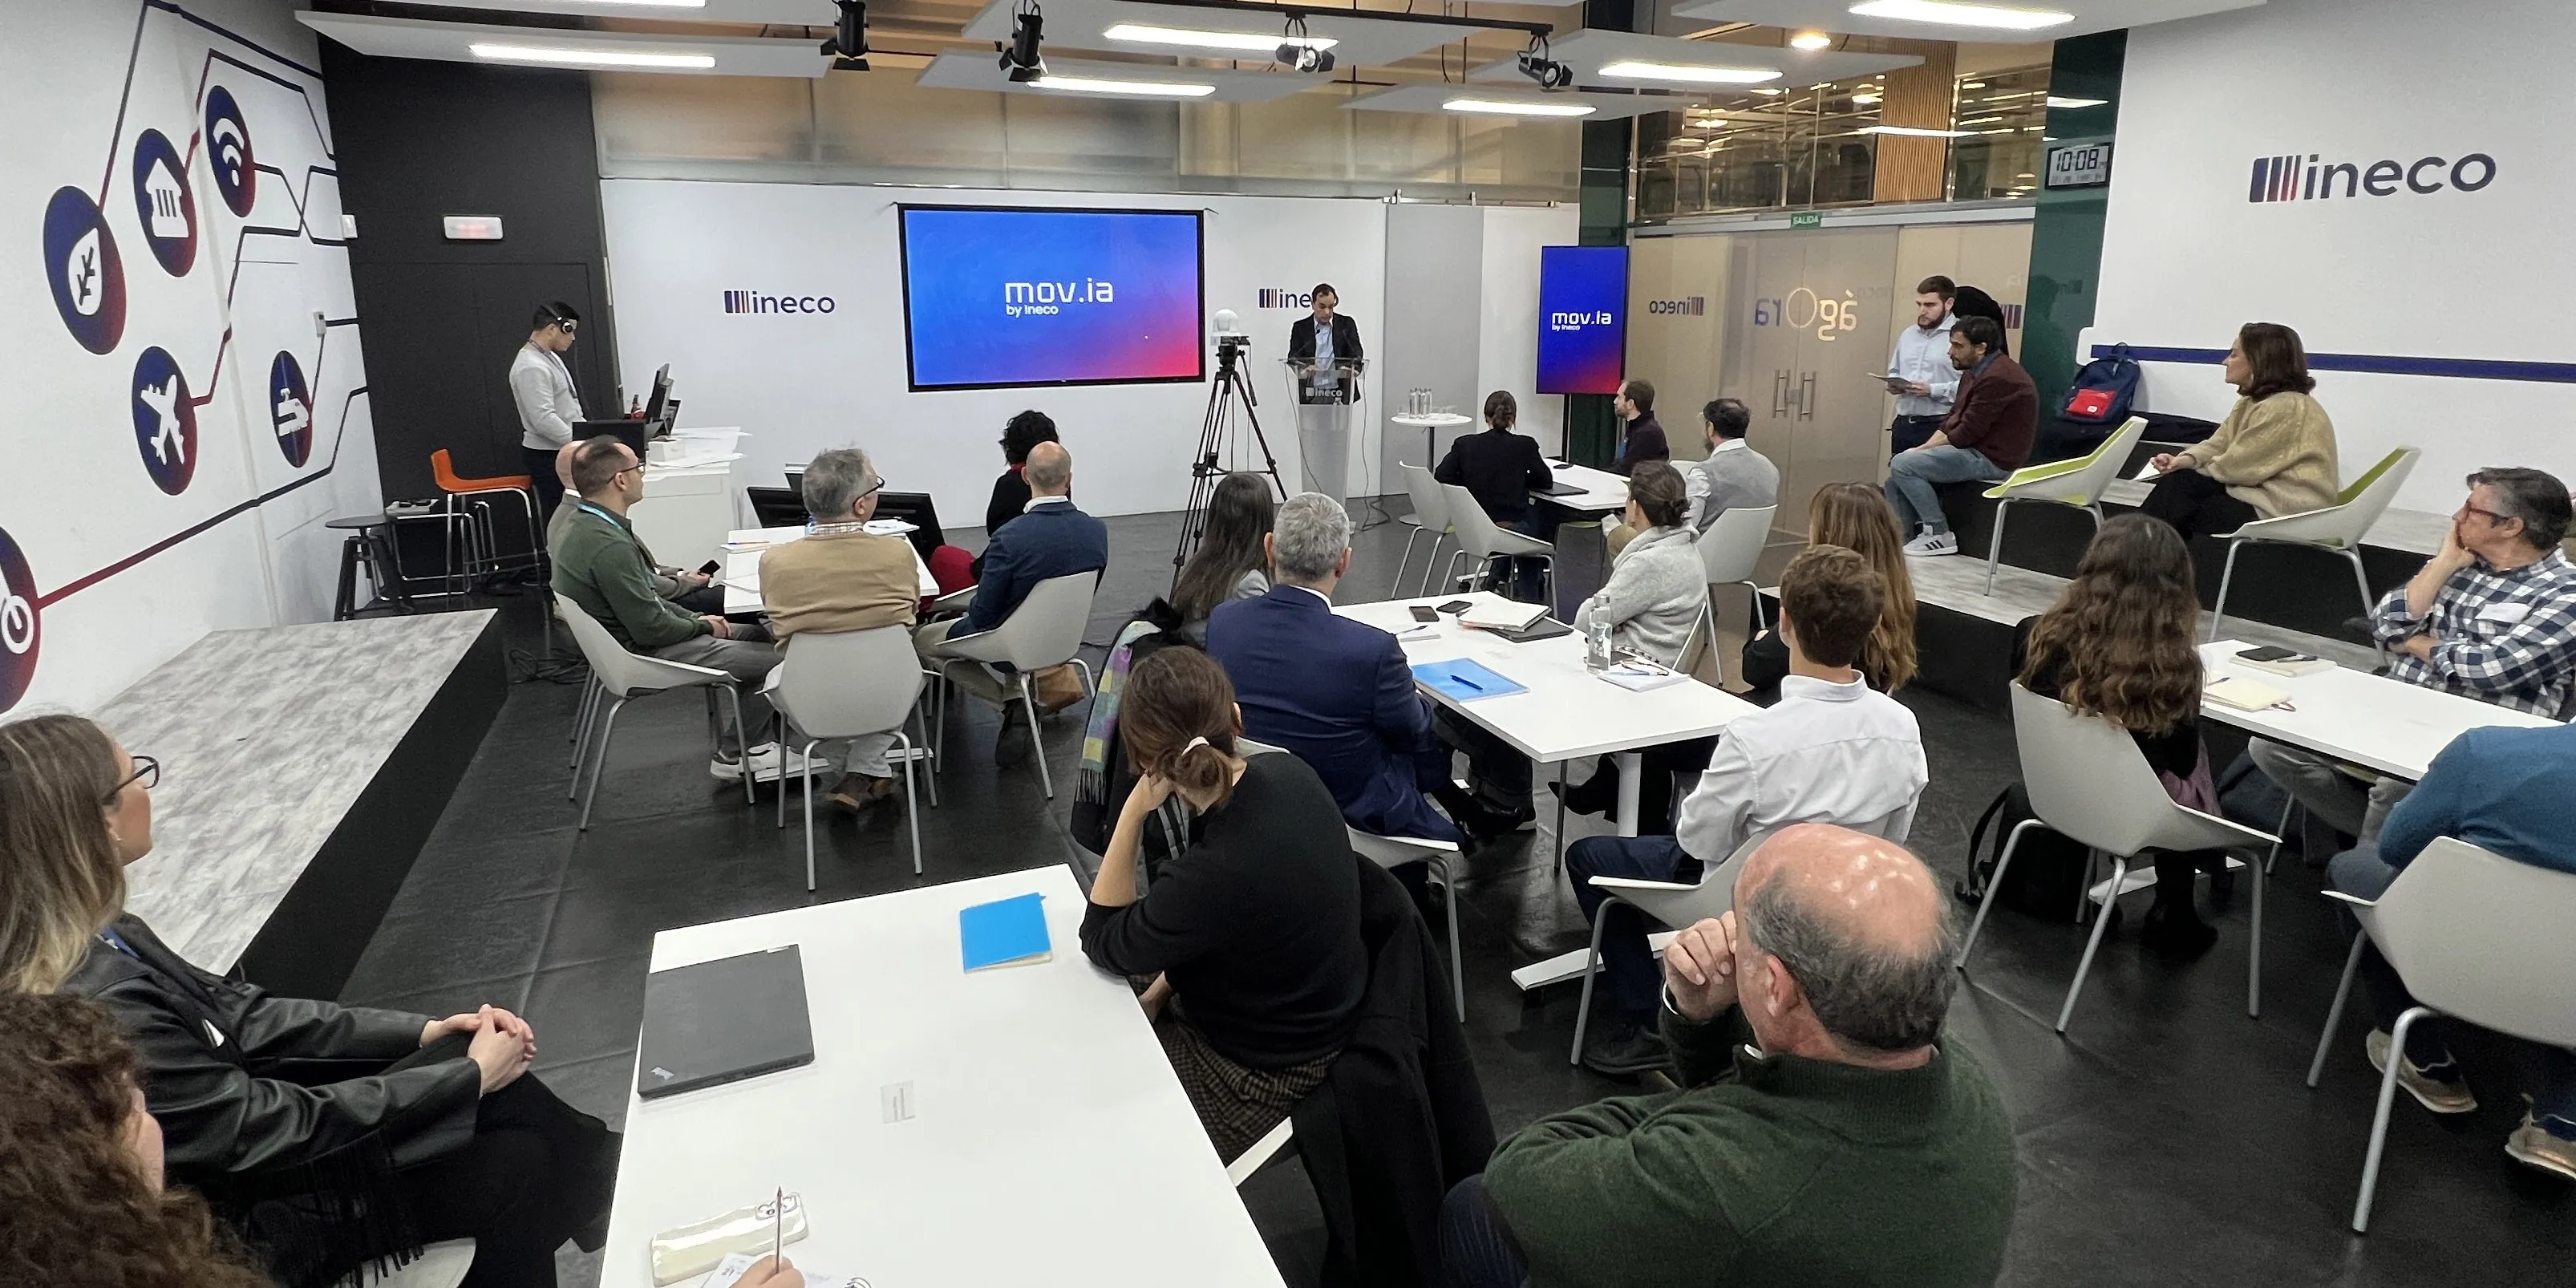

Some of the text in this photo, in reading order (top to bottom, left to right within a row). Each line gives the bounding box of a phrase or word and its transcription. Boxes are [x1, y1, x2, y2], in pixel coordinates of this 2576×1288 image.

[2056, 148, 2100, 172] 10:08
[2303, 152, 2497, 201] ineco
[1792, 215, 1819, 225] SALIDA
[1005, 277, 1114, 304] mov.ia
[1279, 288, 1312, 309] ine
[751, 290, 836, 314] ineco
[1006, 304, 1023, 318] by
[1552, 310, 1612, 325] mov.ia
